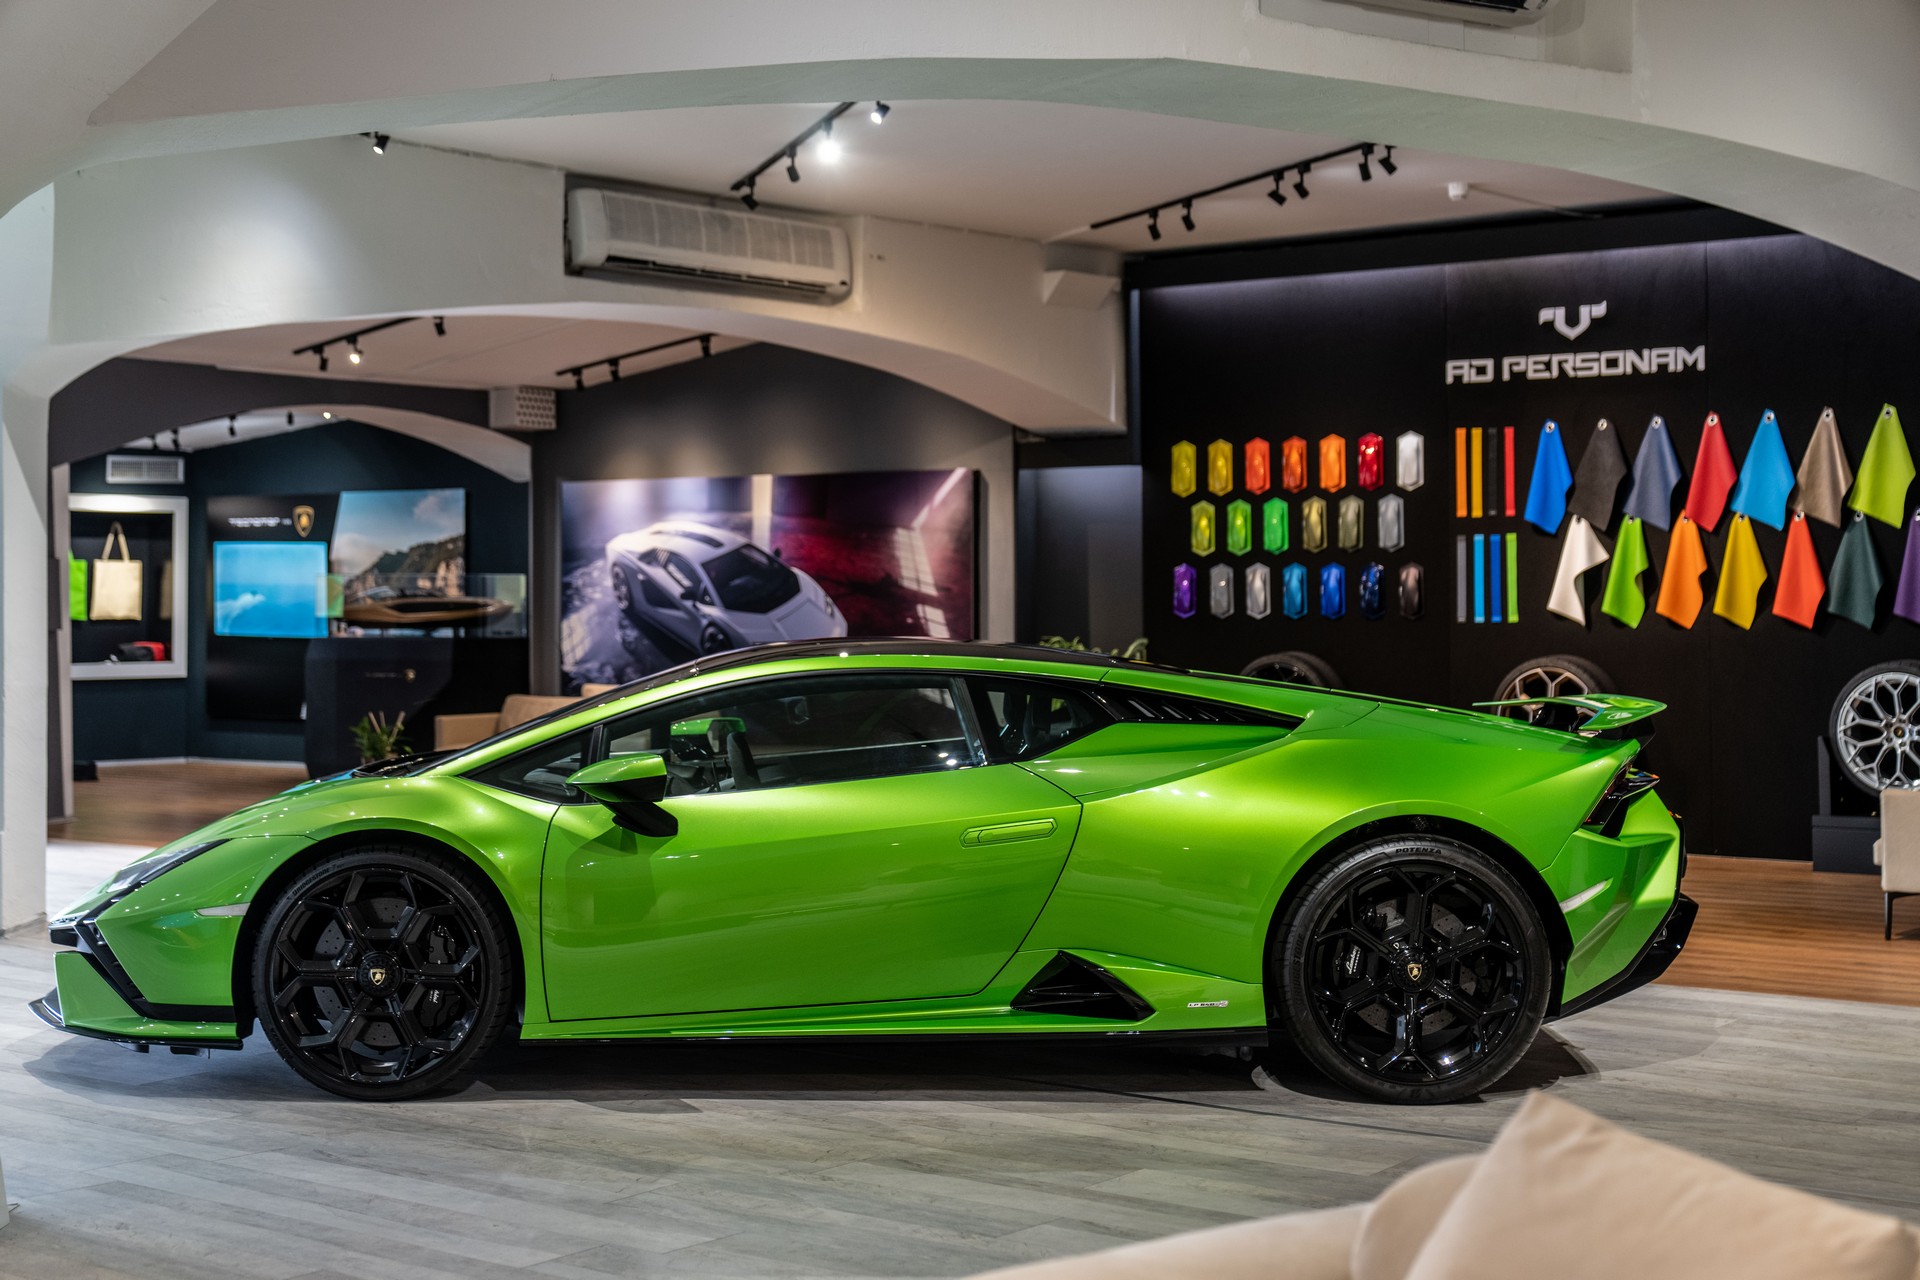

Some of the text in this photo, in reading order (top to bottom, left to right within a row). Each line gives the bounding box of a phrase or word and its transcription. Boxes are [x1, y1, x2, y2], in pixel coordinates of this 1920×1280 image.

[1445, 345, 1706, 385] AD PERSONAM
[1395, 847, 1442, 855] POTENZA
